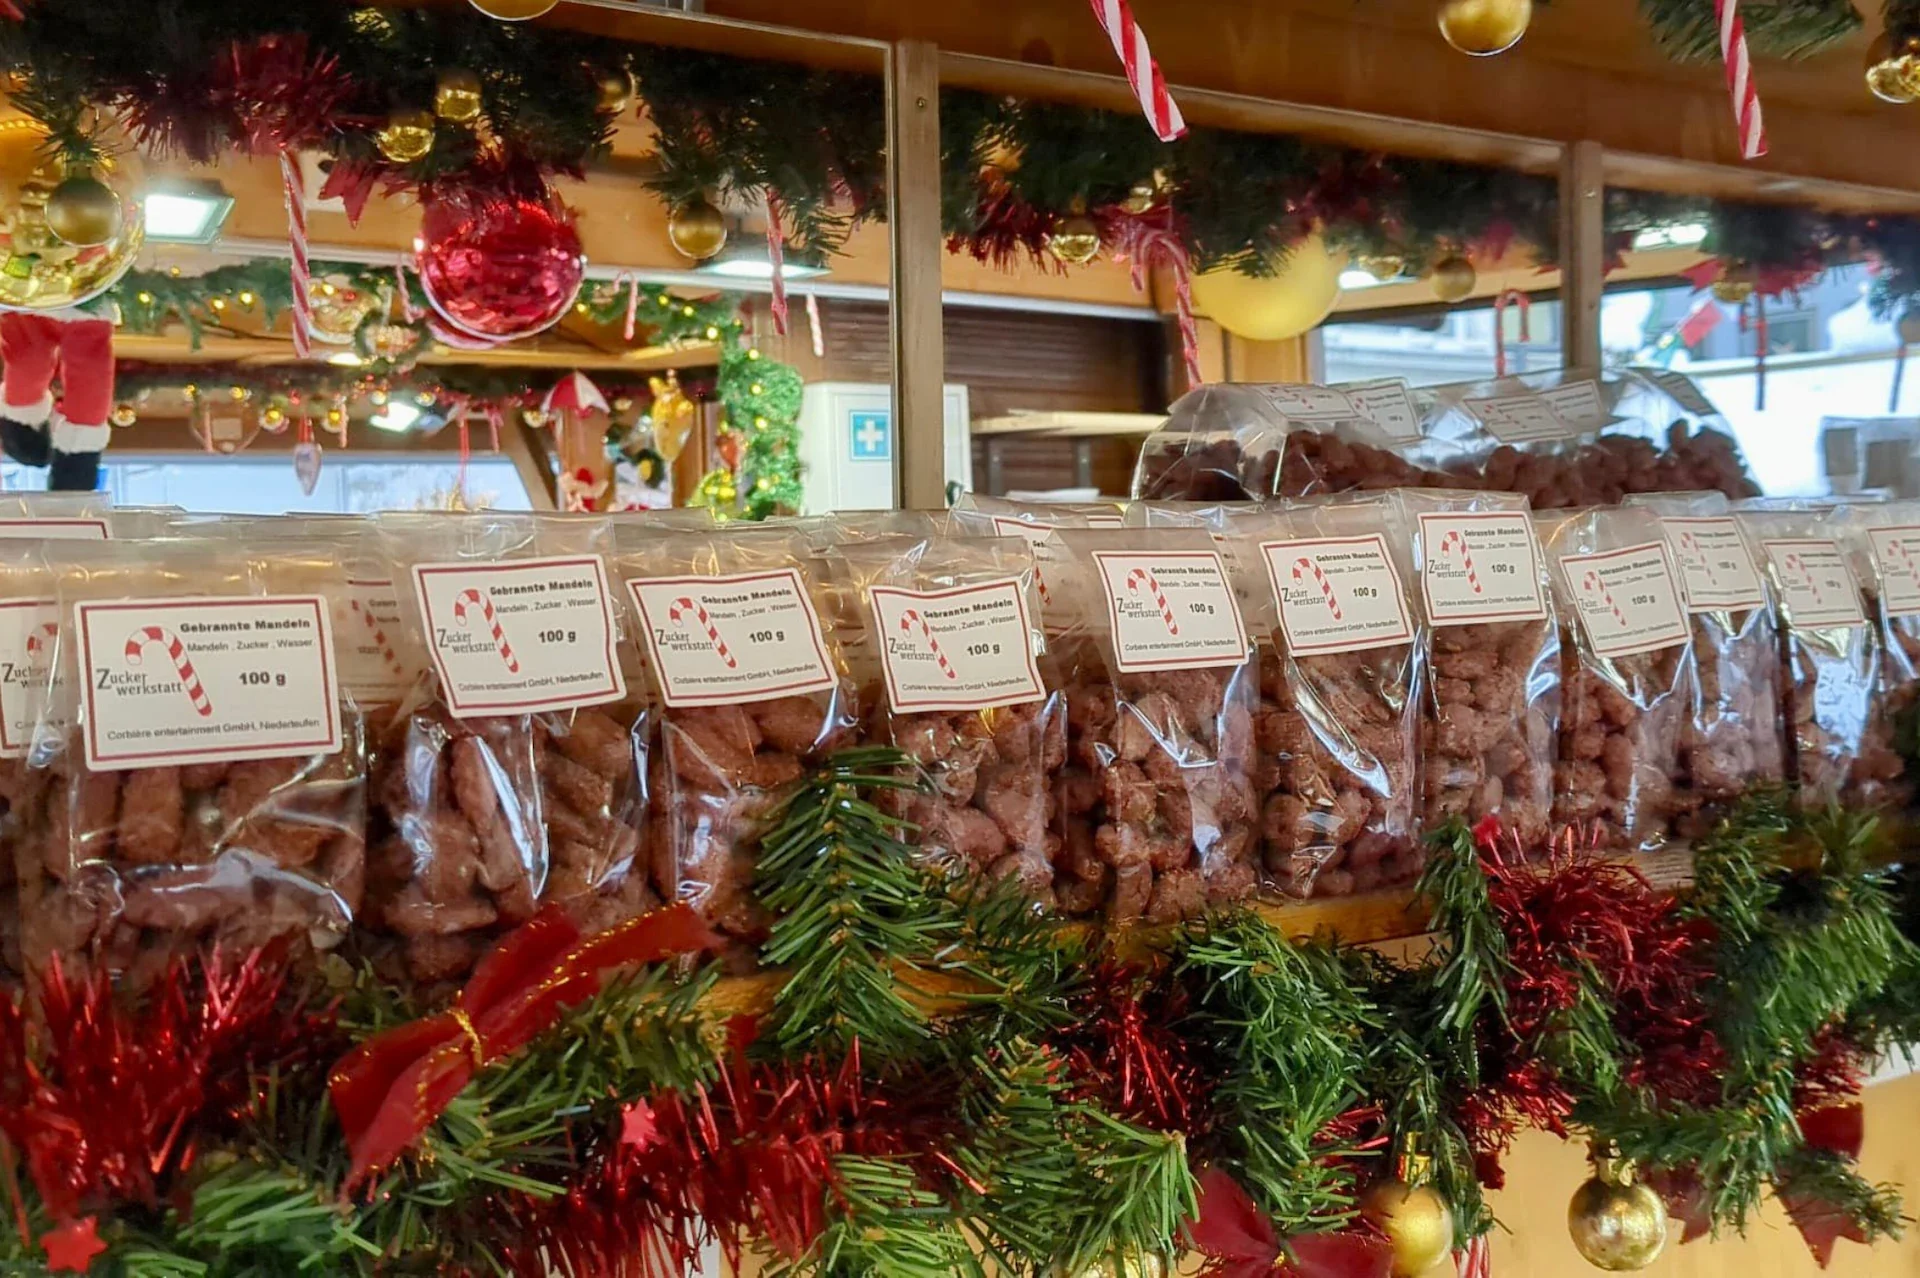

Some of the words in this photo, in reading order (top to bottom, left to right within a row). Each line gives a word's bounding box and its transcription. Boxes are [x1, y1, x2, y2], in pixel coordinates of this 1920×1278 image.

[1492, 564, 1506, 573] 100
[1510, 566, 1514, 574] g
[490, 584, 545, 595] Gebrannte
[549, 580, 592, 590] Mandeln
[1353, 587, 1368, 597] 100
[1372, 588, 1377, 597] g
[702, 595, 748, 603] Gebrannte
[751, 589, 791, 599] Mandeln
[496, 605, 528, 613] Mandeln
[534, 602, 561, 610] Zucker
[924, 607, 969, 618] Gebrannte
[973, 600, 1013, 611] Mandeln
[1117, 597, 1142, 612] Zucker
[1190, 604, 1205, 613] 100
[1209, 605, 1214, 614] g
[742, 608, 765, 617] Zucker
[181, 622, 250, 632] Gebrannte
[255, 619, 310, 629] Mandeln
[961, 621, 985, 629] Zucker
[437, 629, 471, 648] Zucker
[539, 629, 563, 642] 100
[568, 631, 575, 642] g
[655, 629, 689, 645] Zucker
[750, 631, 772, 643] 100
[776, 631, 784, 641] g
[187, 642, 228, 651] Mandeln
[237, 640, 269, 650] Zucker
[452, 642, 496, 653] werkstatt
[671, 641, 714, 651] werkstatt
[889, 638, 915, 654] Zucker
[967, 644, 989, 656] 100
[993, 644, 1000, 654] g
[900, 652, 934, 660] werkstatt
[96, 668, 147, 690] Zucker
[239, 672, 270, 685] 100
[276, 673, 286, 686] g
[116, 682, 182, 696] werkstatt
[154, 725, 220, 737] entertainment
[223, 722, 256, 733] GmbH,
[260, 718, 320, 730] Niederteufen
